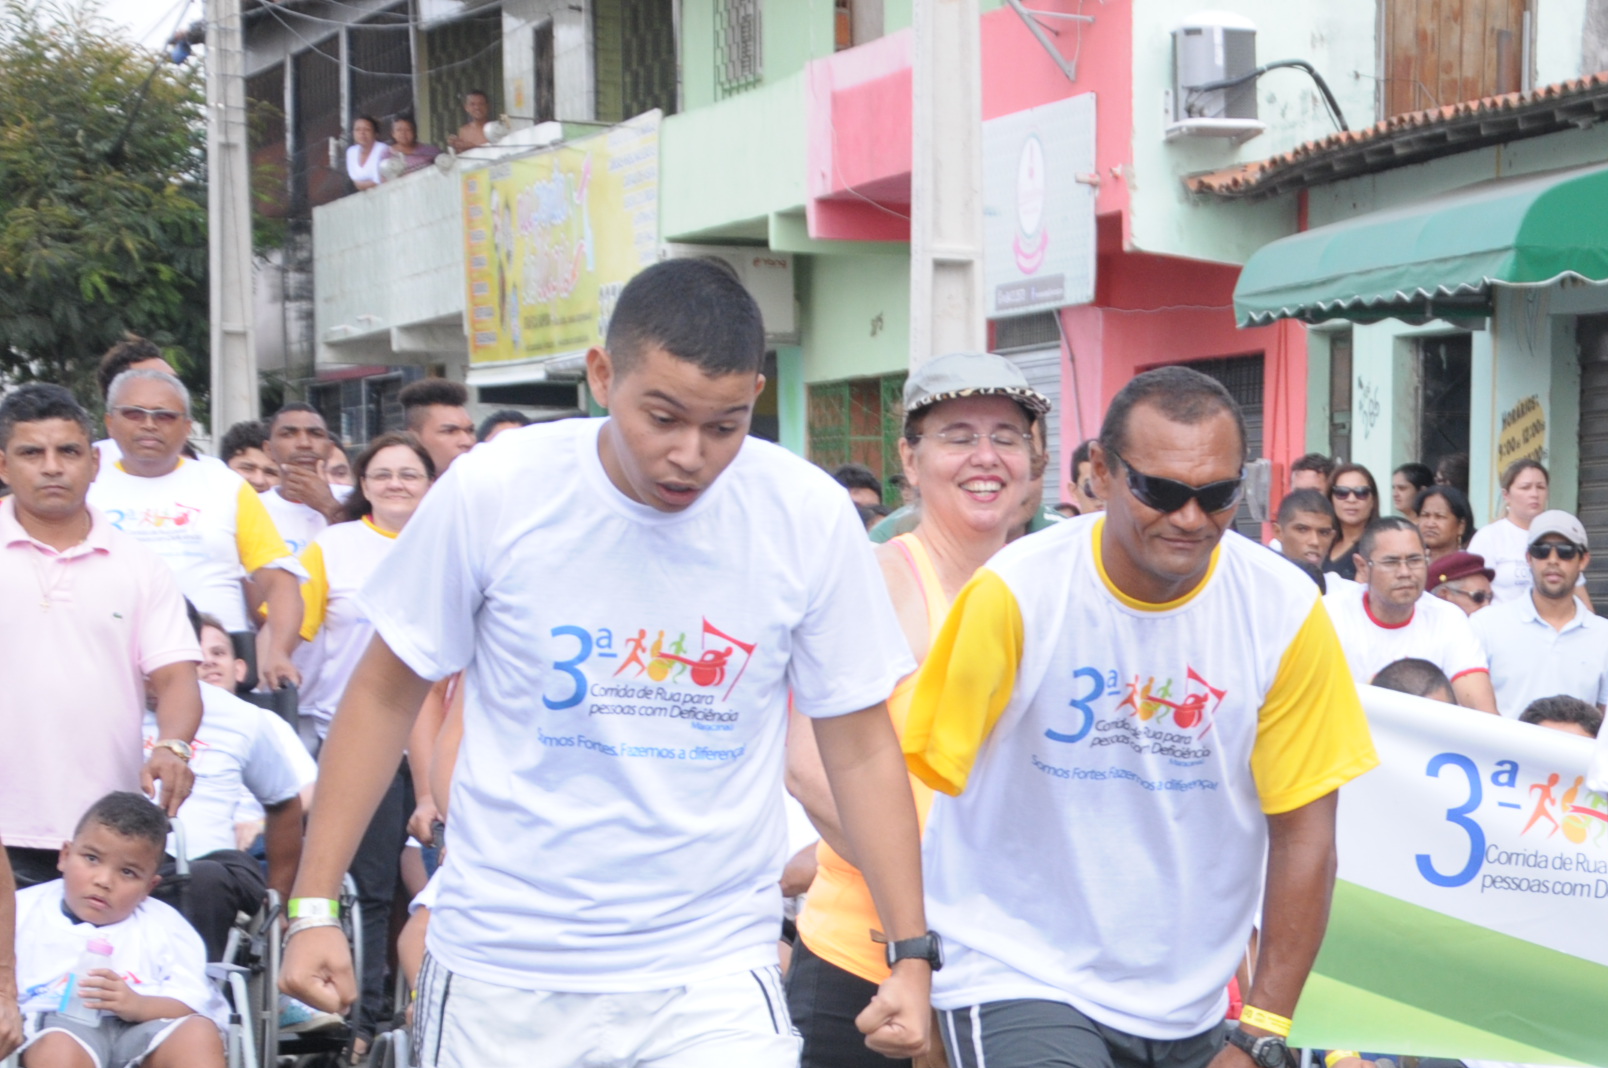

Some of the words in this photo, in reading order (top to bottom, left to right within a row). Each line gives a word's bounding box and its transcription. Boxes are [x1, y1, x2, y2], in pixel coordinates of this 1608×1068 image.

[542, 625, 617, 711] 3ª
[636, 685, 653, 700] de
[655, 687, 681, 703] Rua
[682, 692, 714, 706] para
[1044, 666, 1121, 743] 3ª
[588, 702, 636, 717] pessoas
[638, 704, 668, 718] com
[669, 704, 739, 723] Deficiência
[1415, 751, 1522, 888] 3ª
[1485, 843, 1549, 869] Corrida
[1552, 852, 1573, 871] de
[1576, 852, 1608, 874] Rua
[1480, 874, 1550, 894] pessoas
[1552, 878, 1592, 898] com
